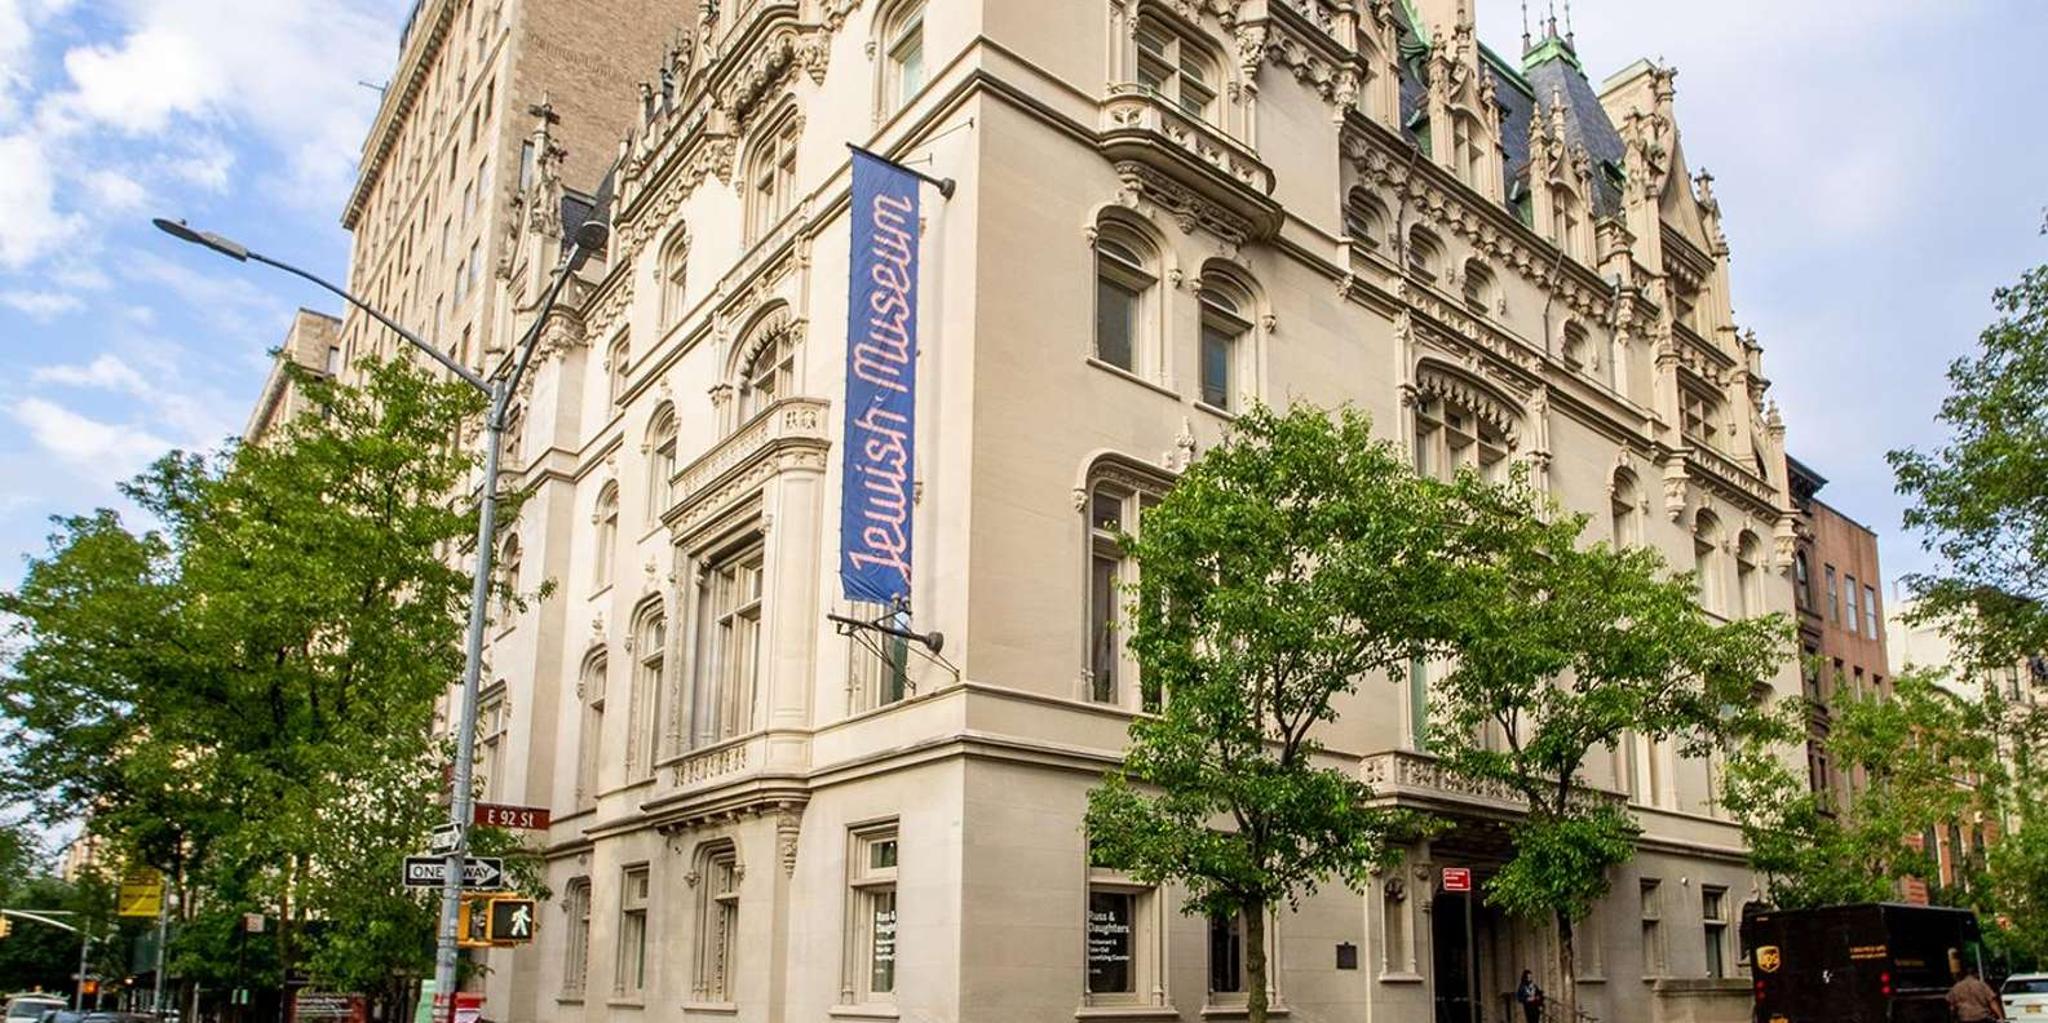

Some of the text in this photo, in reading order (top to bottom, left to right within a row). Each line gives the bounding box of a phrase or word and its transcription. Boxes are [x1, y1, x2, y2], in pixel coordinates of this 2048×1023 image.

[848, 193, 913, 586] Jewish Museum
[487, 809, 534, 827] E 92 St
[412, 865, 490, 879] ONE WAY
[1108, 911, 1115, 921] &
